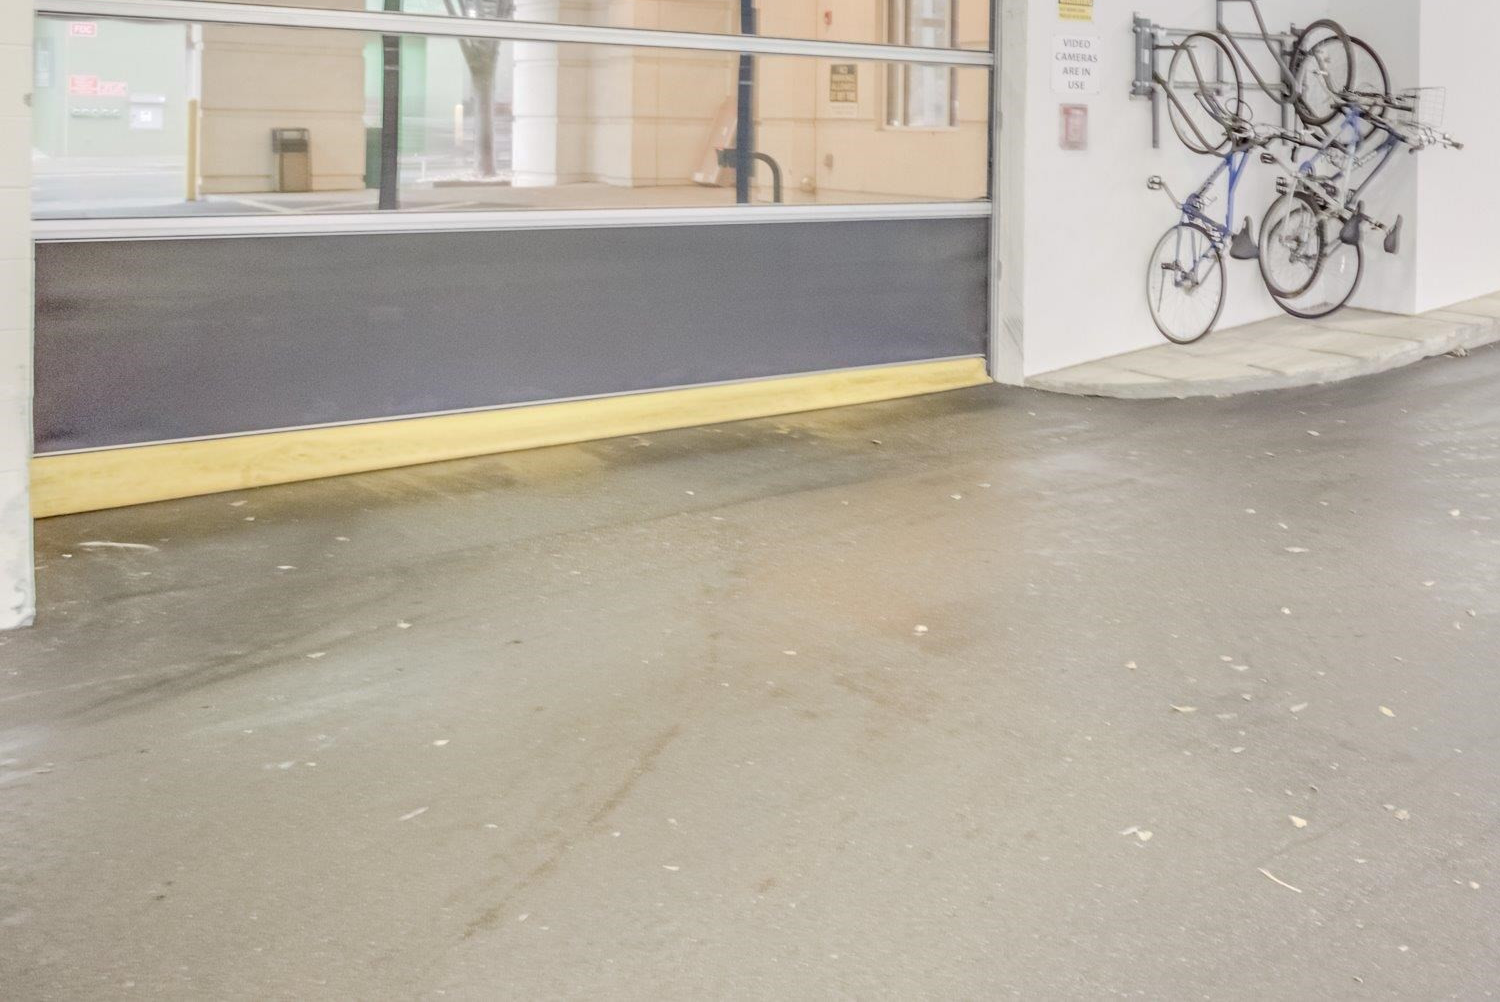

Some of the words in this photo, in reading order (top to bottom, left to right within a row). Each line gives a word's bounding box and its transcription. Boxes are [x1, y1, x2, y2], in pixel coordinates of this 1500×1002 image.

[1063, 39, 1091, 49] VIDEO
[1055, 52, 1098, 63] CAMERAS
[1062, 66, 1080, 76] ARE
[1081, 67, 1091, 76] IN
[1068, 80, 1085, 90] USE
